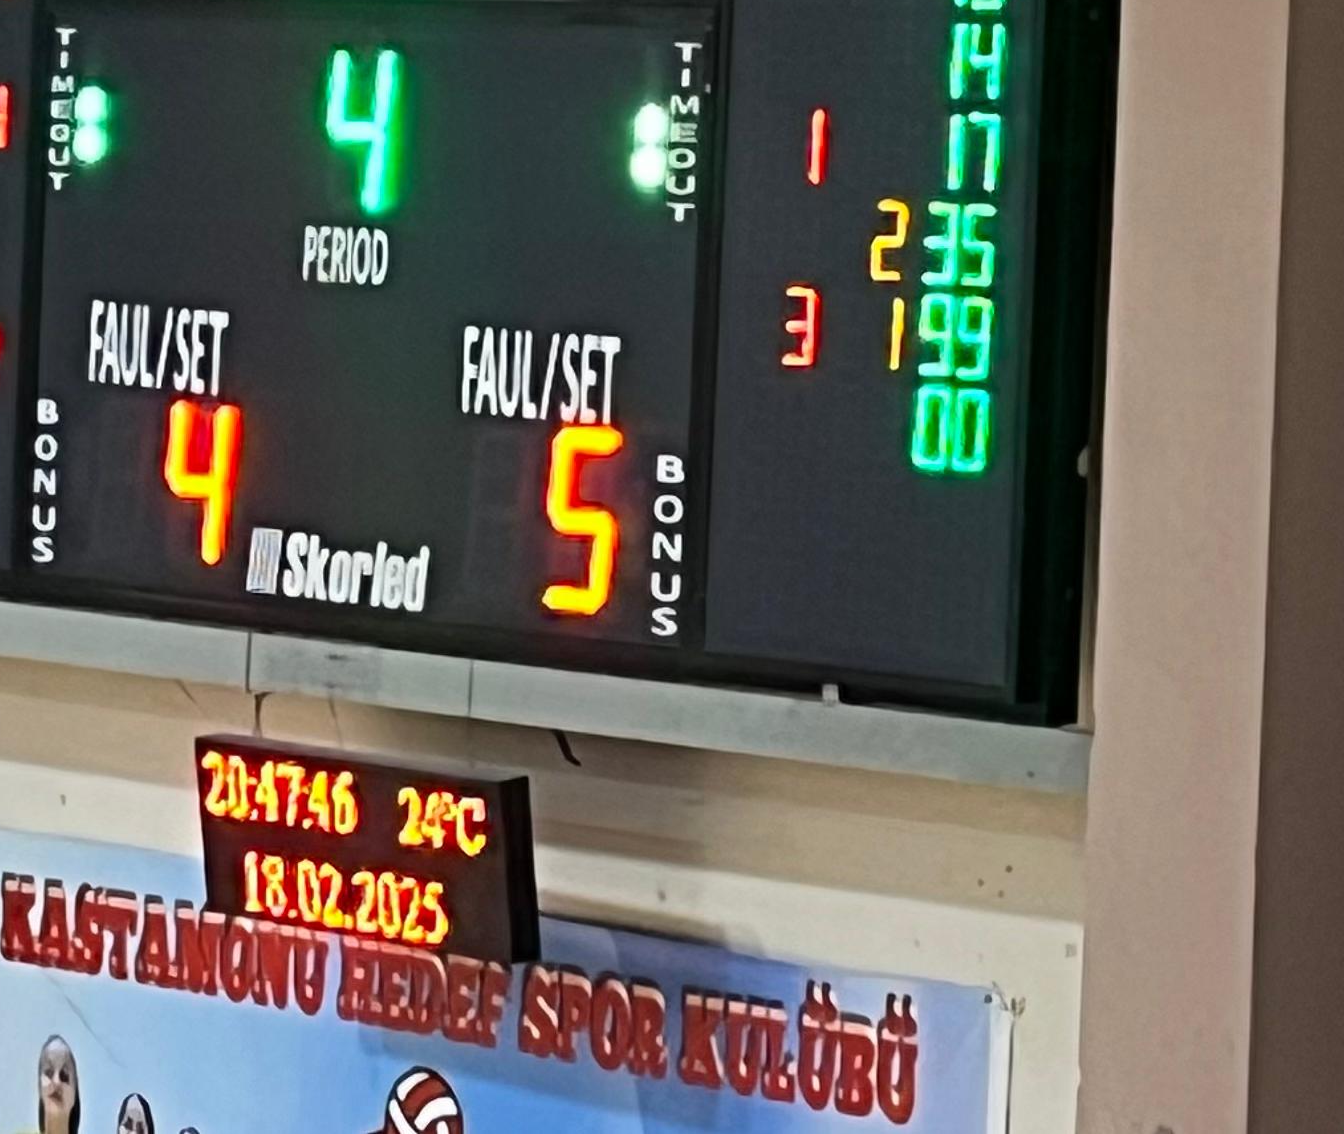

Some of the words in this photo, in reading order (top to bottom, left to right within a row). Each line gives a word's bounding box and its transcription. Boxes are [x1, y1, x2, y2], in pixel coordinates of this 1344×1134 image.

[50, 26, 77, 191] TIMEOUT
[951, 22, 1005, 100] 14
[326, 49, 399, 214] 4
[665, 42, 702, 222] TIMEOUT
[807, 108, 826, 185] 1
[946, 112, 1001, 193] 17
[303, 226, 388, 285] PERIOD
[870, 198, 910, 282] 2
[921, 201, 997, 288] 35
[88, 300, 229, 397] FAUL/SET
[461, 325, 621, 425] FAUL/SET
[781, 285, 818, 367] 3
[889, 298, 905, 371] 1
[918, 292, 993, 381] 99
[911, 386, 991, 474] 00
[31, 398, 59, 563] BONUS
[164, 399, 242, 564] 4
[542, 425, 623, 614] 5
[282, 532, 430, 612] Skorled
[650, 454, 685, 636] BONUS
[244, 851, 449, 945] 18.02.2025
[0, 871, 329, 1016] KASTAMONU
[337, 933, 512, 1049] HEDEF
[517, 964, 668, 1079] SPOR
[677, 979, 919, 1125] KULÜBÜ
